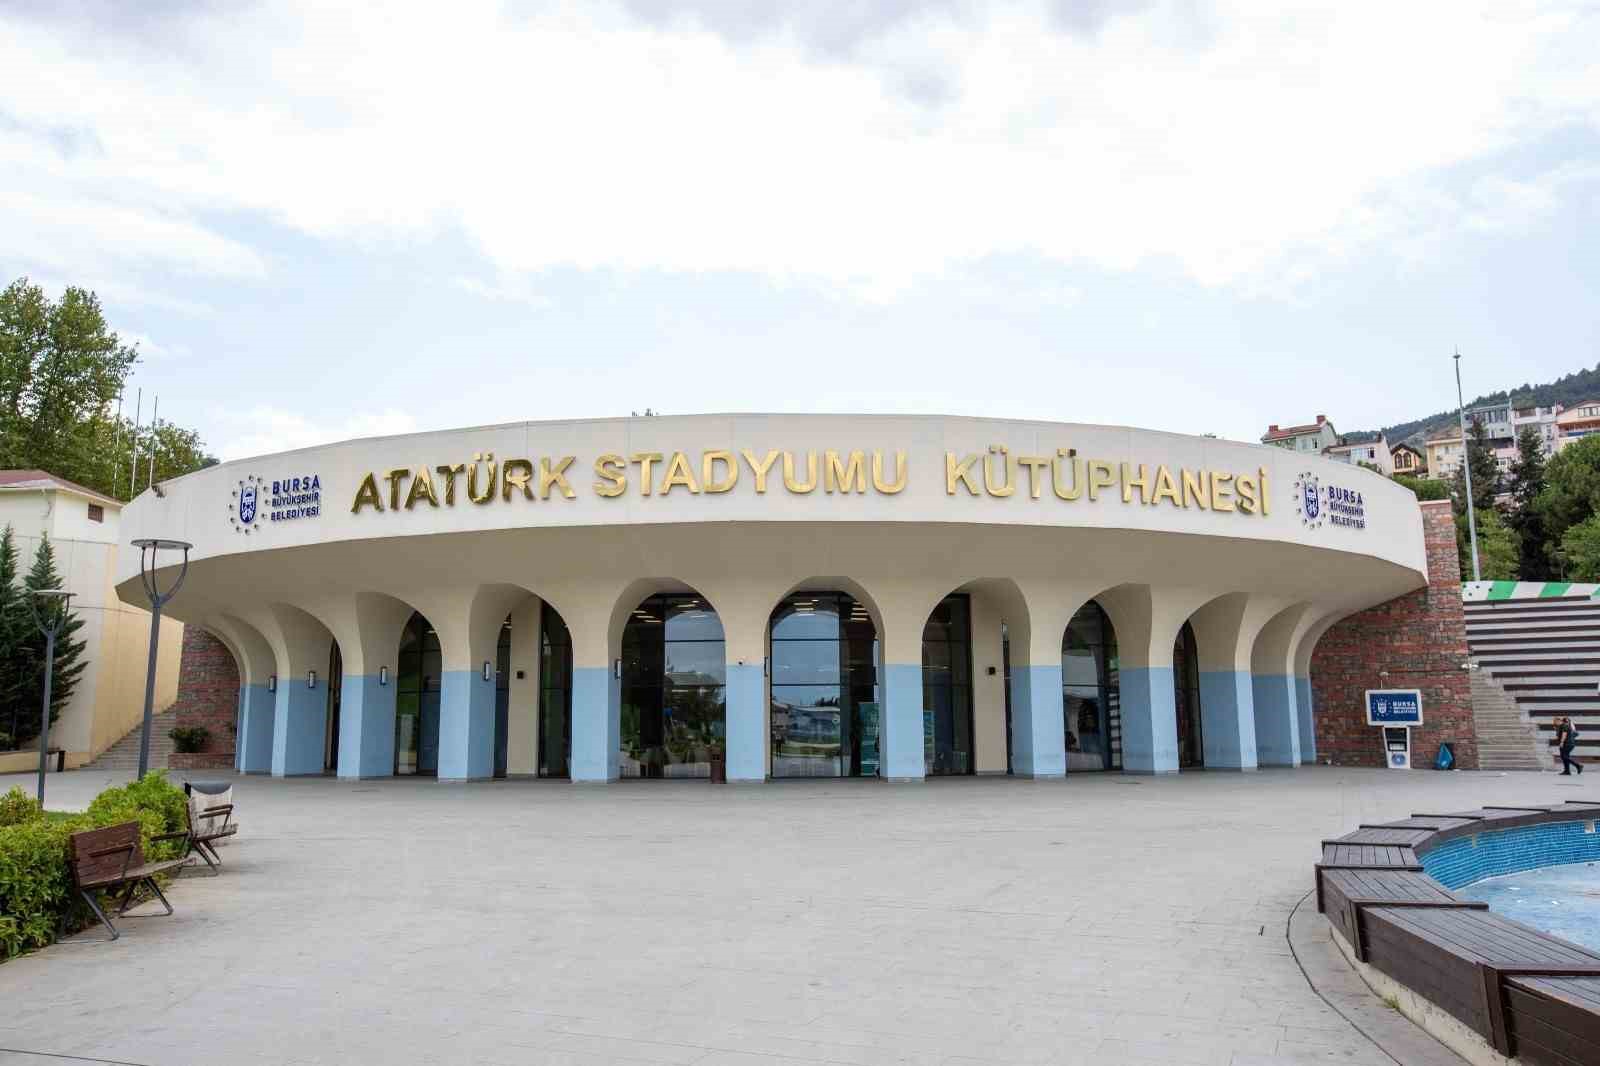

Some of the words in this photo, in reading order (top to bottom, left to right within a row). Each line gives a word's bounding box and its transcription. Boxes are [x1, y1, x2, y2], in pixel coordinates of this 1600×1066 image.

[272, 475, 320, 495] BURSA
[352, 453, 577, 515] ATATÜRK
[593, 448, 908, 498] STADYUMU
[944, 444, 1269, 516] KÜTÜPHANESİ
[1329, 486, 1363, 505] BURSA
[271, 506, 319, 521] BELEDİYESİ
